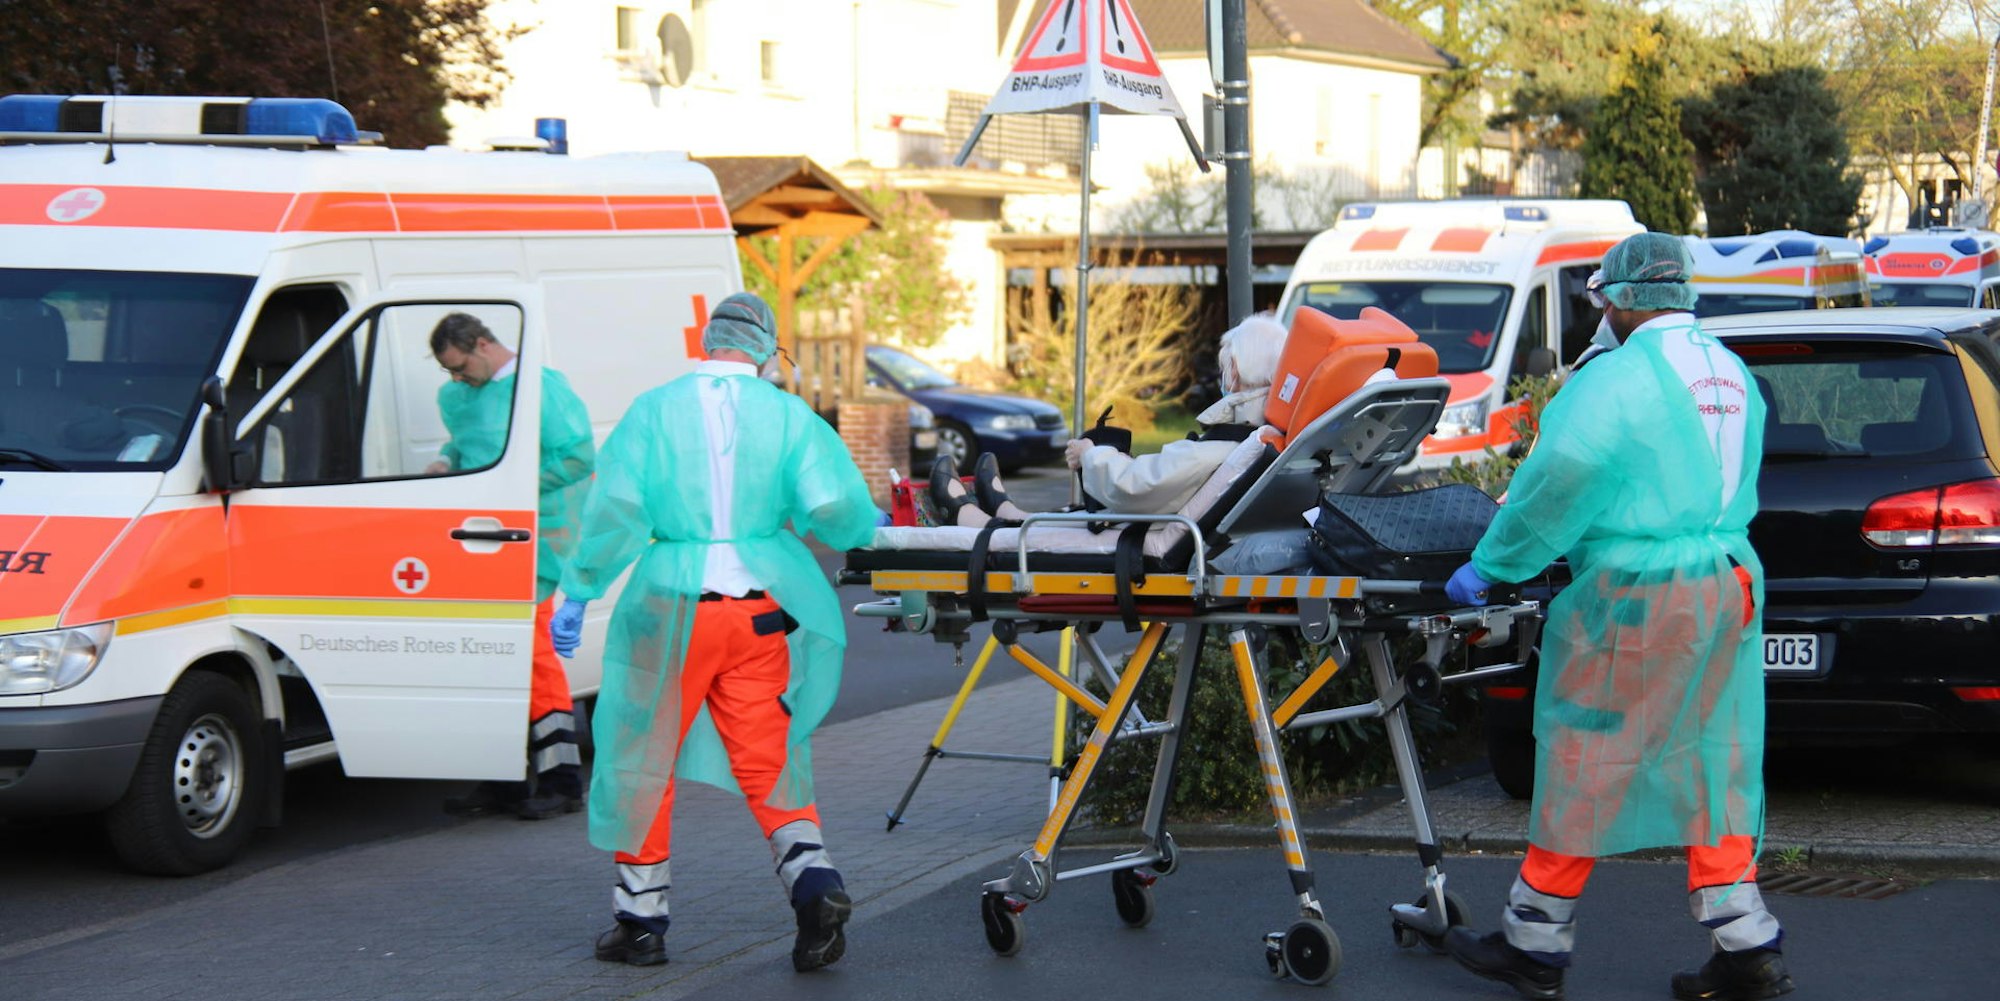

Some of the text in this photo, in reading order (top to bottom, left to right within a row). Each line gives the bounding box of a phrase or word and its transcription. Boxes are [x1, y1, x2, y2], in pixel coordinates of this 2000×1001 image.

[1011, 72, 1083, 92] BHP-Ausgang
[1103, 69, 1163, 99] BHP-Ausgang
[1320, 257, 1501, 275] RETTUNGSDIENST
[299, 633, 516, 655] Deutsches Rotes Kreuz
